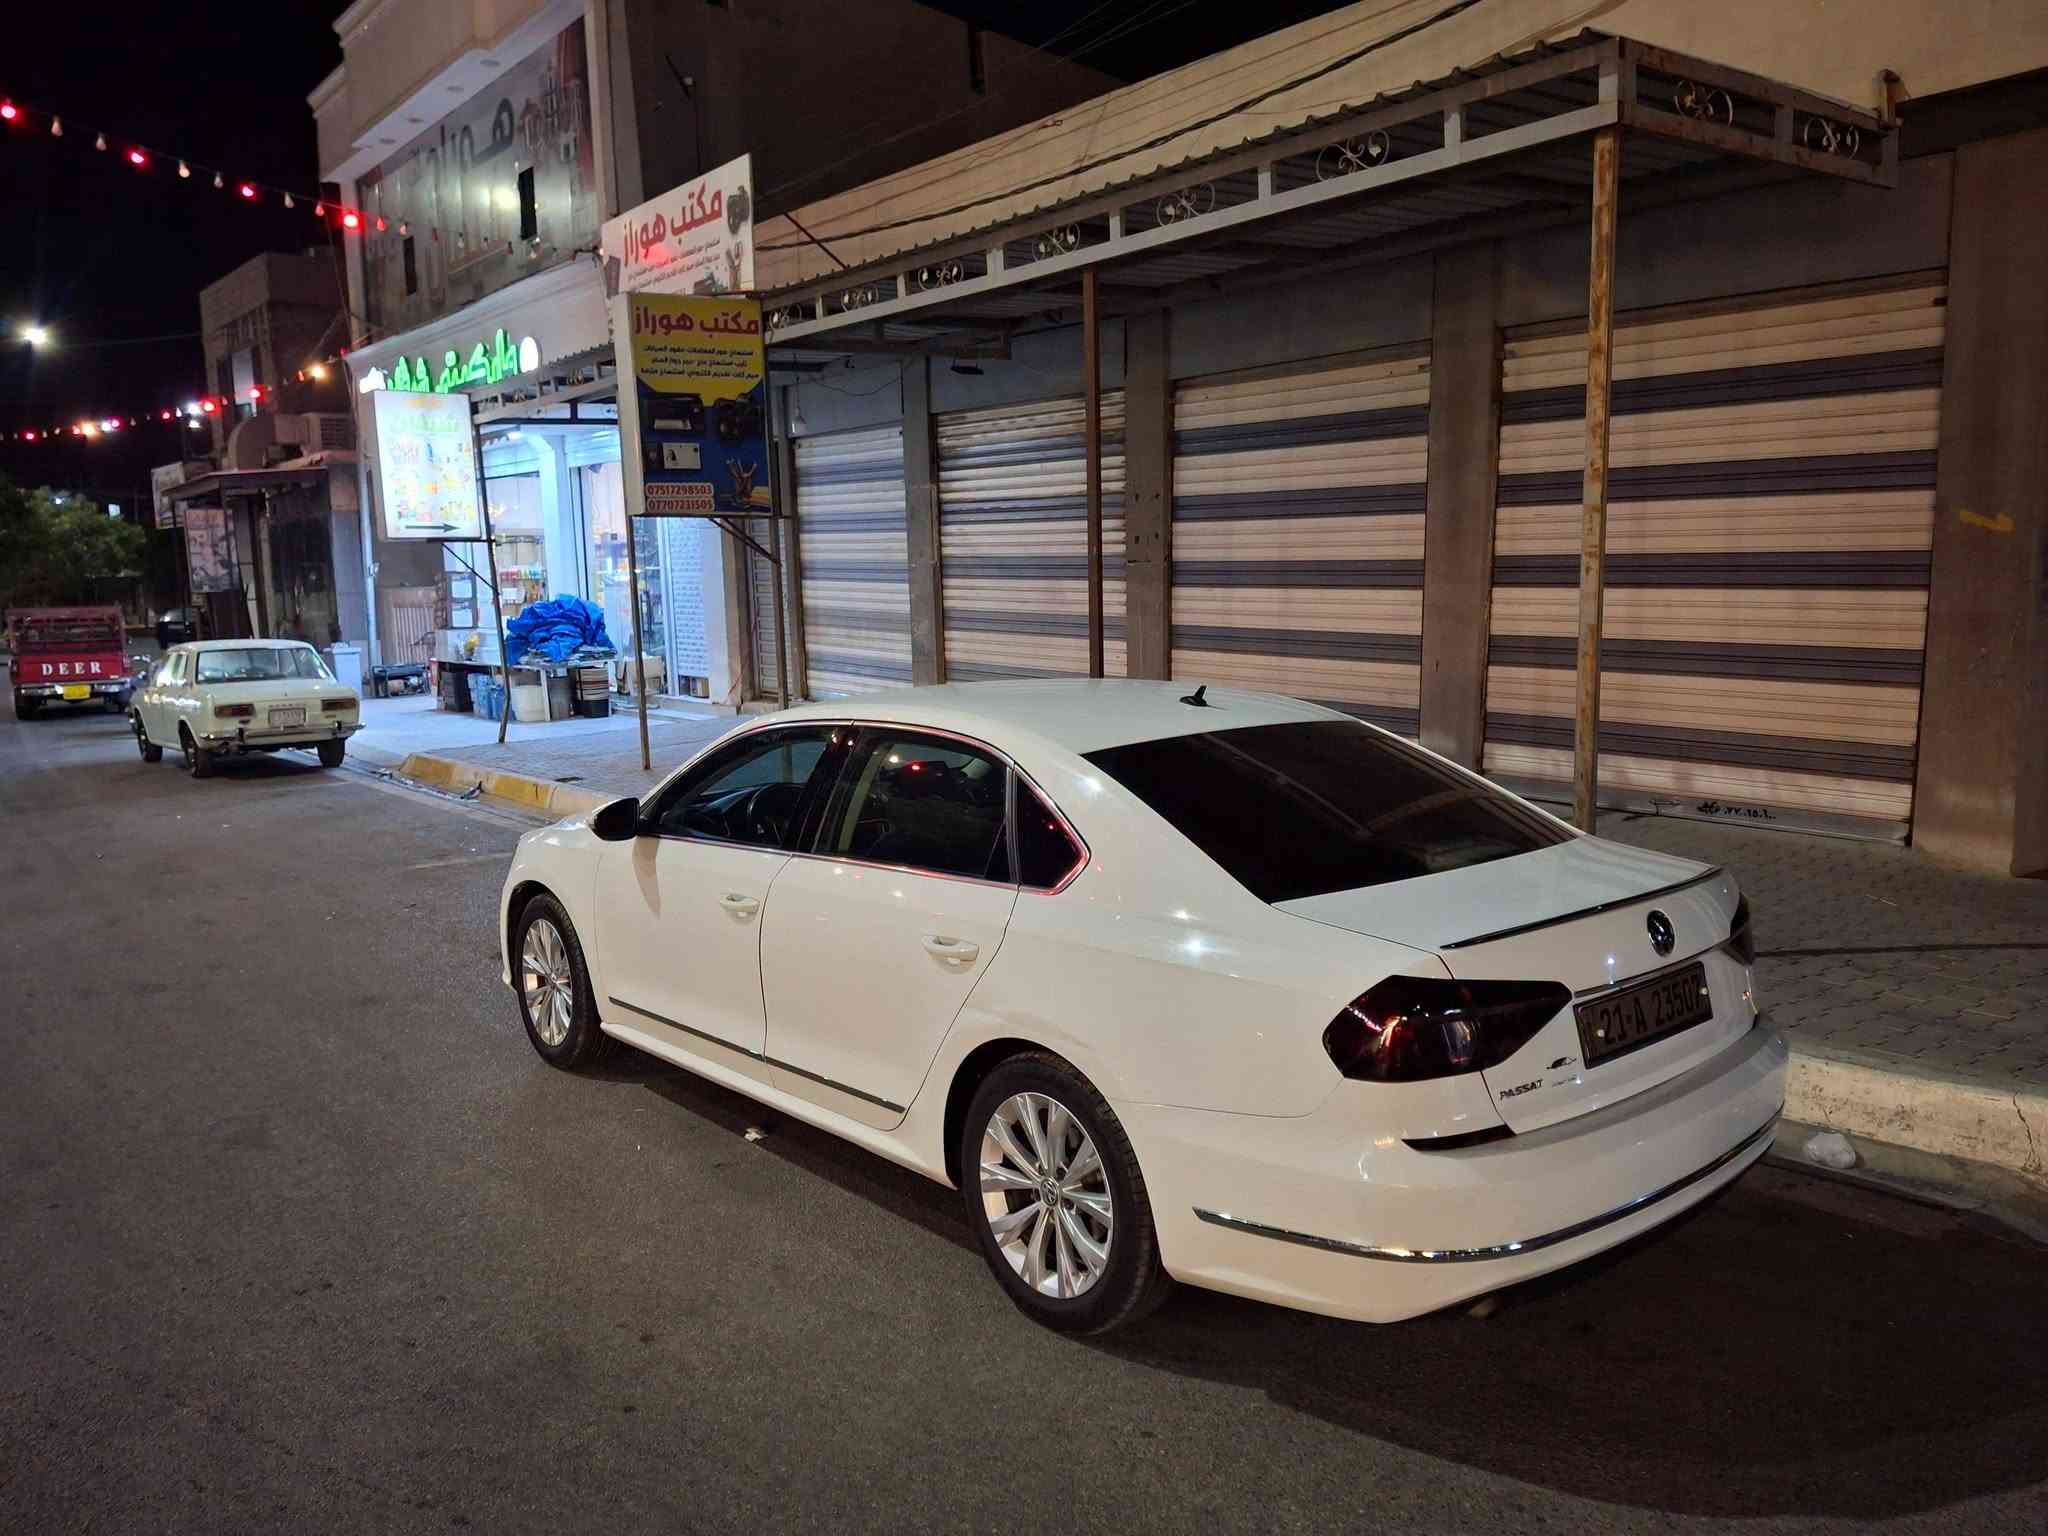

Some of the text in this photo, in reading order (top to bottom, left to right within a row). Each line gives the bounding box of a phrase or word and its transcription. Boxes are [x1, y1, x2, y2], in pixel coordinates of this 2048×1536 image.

[671, 180, 722, 245] مكتب
[635, 306, 759, 337] مكتب هوراز
[42, 661, 101, 676] DEER
[1500, 1078, 1544, 1101] PASSAT
